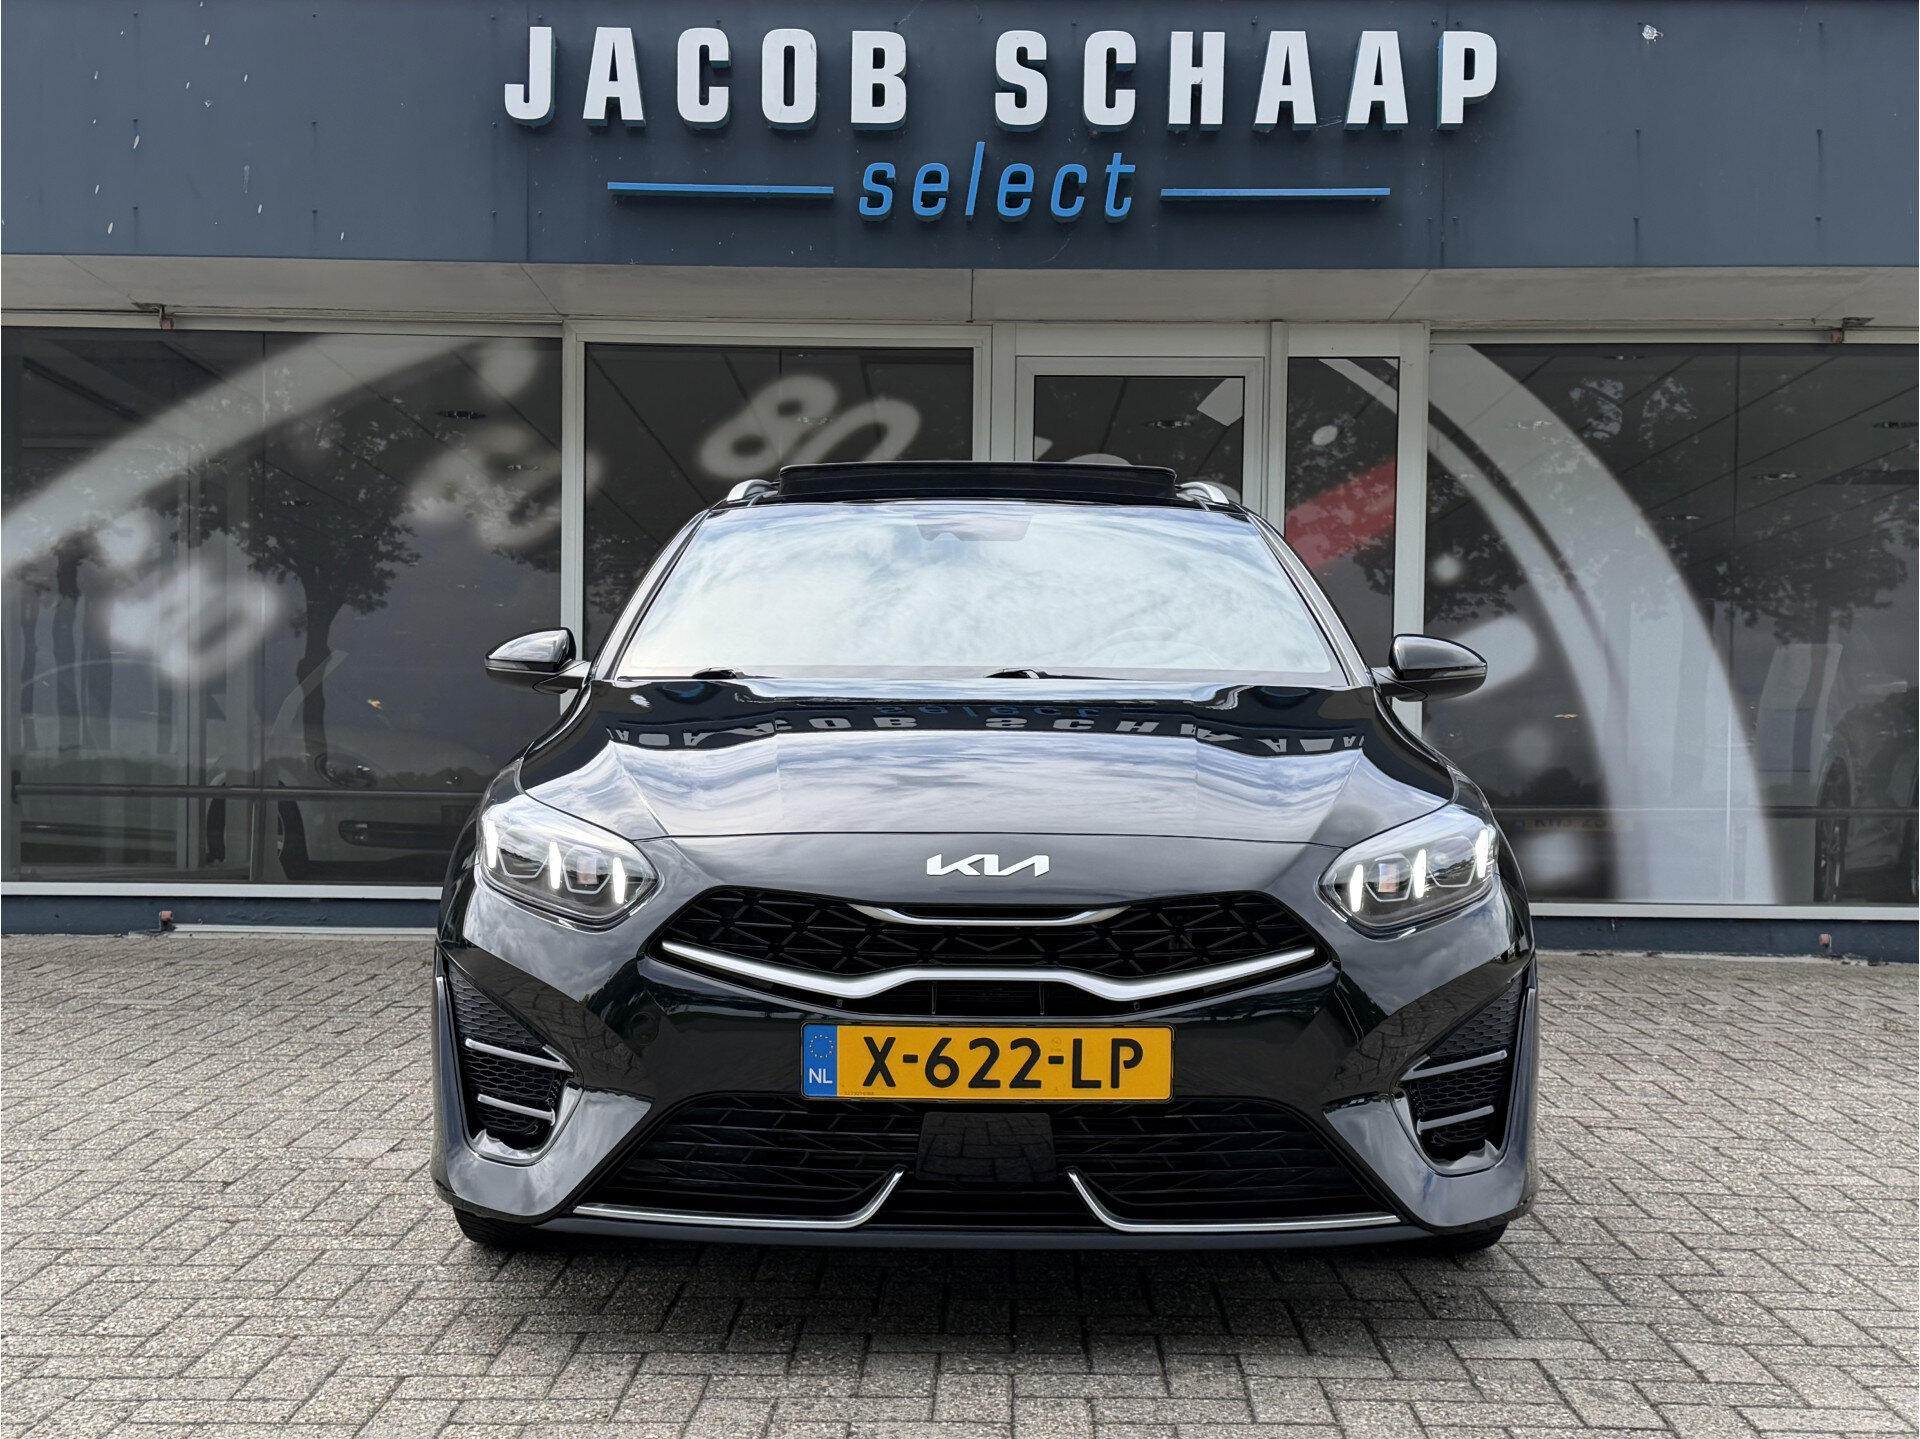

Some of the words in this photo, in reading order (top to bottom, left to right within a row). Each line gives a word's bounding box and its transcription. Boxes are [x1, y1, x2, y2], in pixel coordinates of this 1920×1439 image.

[504, 26, 908, 130] JACOB
[994, 30, 1499, 131] SCHAAP
[858, 141, 1136, 222] select
[926, 853, 1050, 877] KIA
[808, 1067, 833, 1085] NL
[862, 1036, 1144, 1090] X-622-LP
